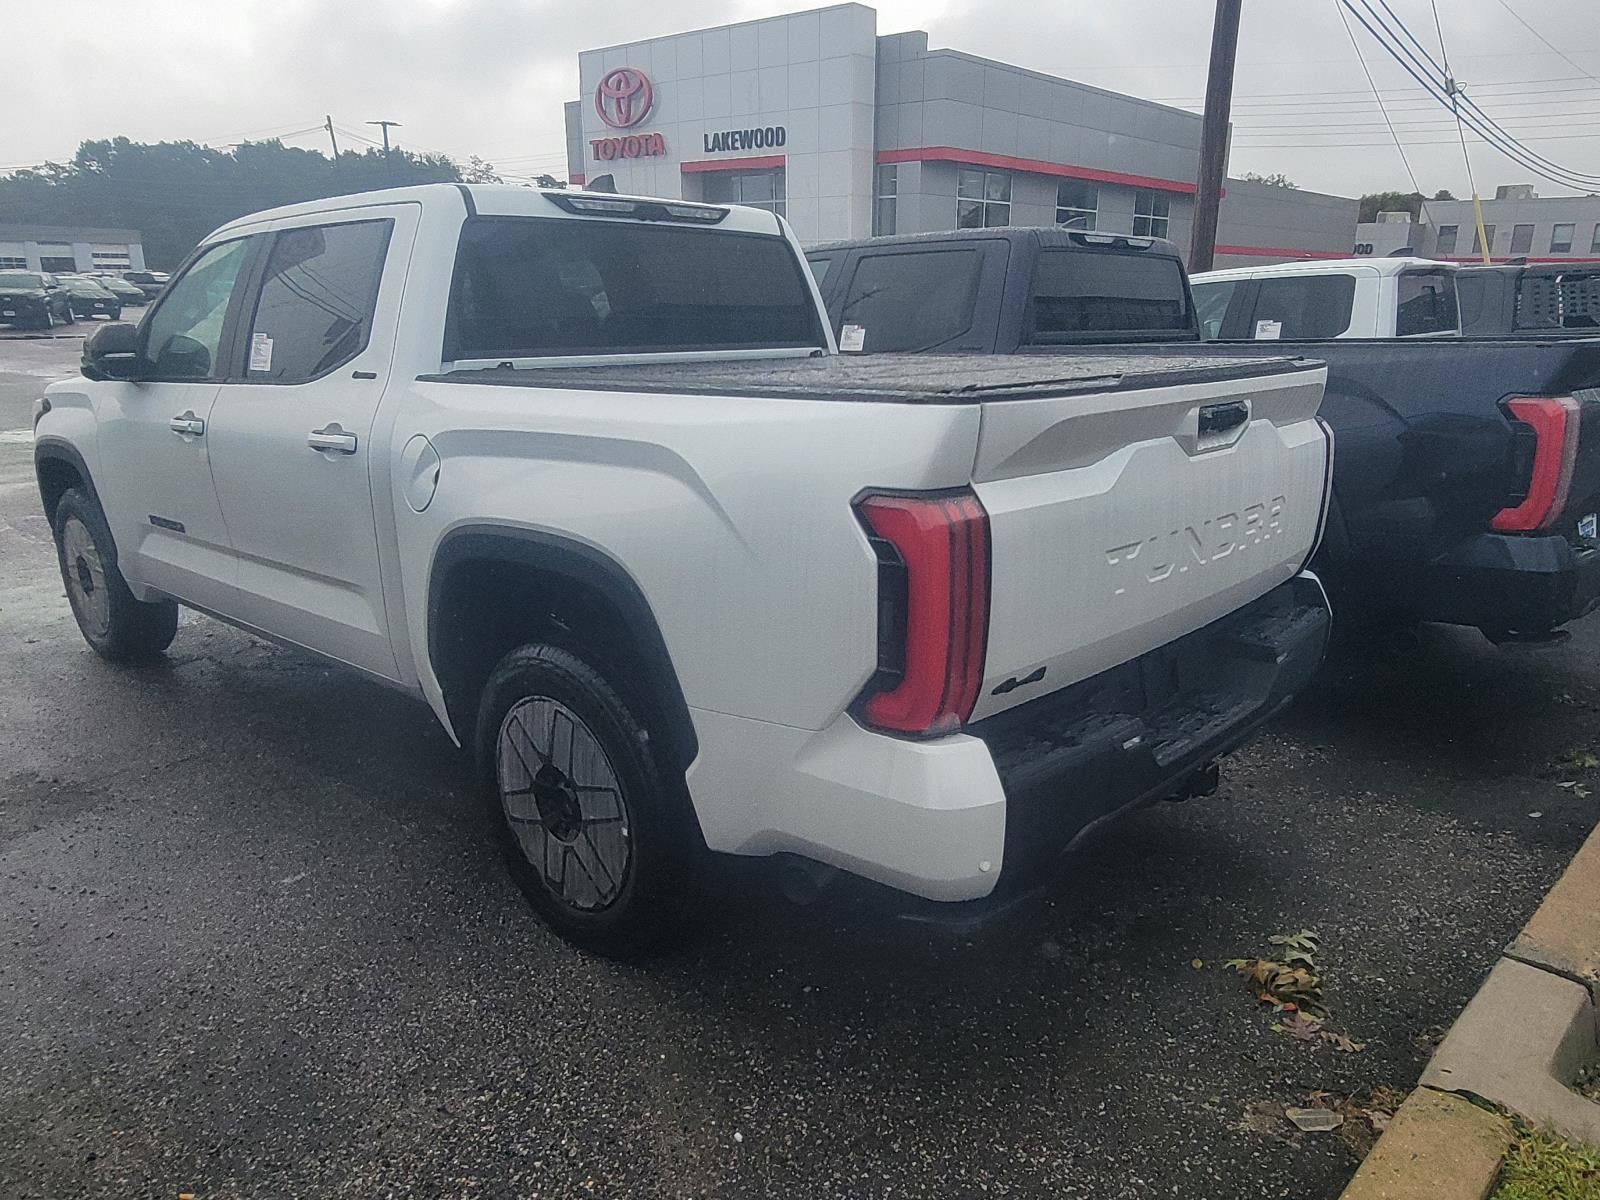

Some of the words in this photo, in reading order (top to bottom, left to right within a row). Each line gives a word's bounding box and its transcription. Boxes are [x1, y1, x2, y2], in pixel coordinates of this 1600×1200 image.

[589, 133, 666, 161] TOYOTA
[703, 126, 786, 153] LAKEWOOD
[1105, 495, 1286, 595] TUNDRA
